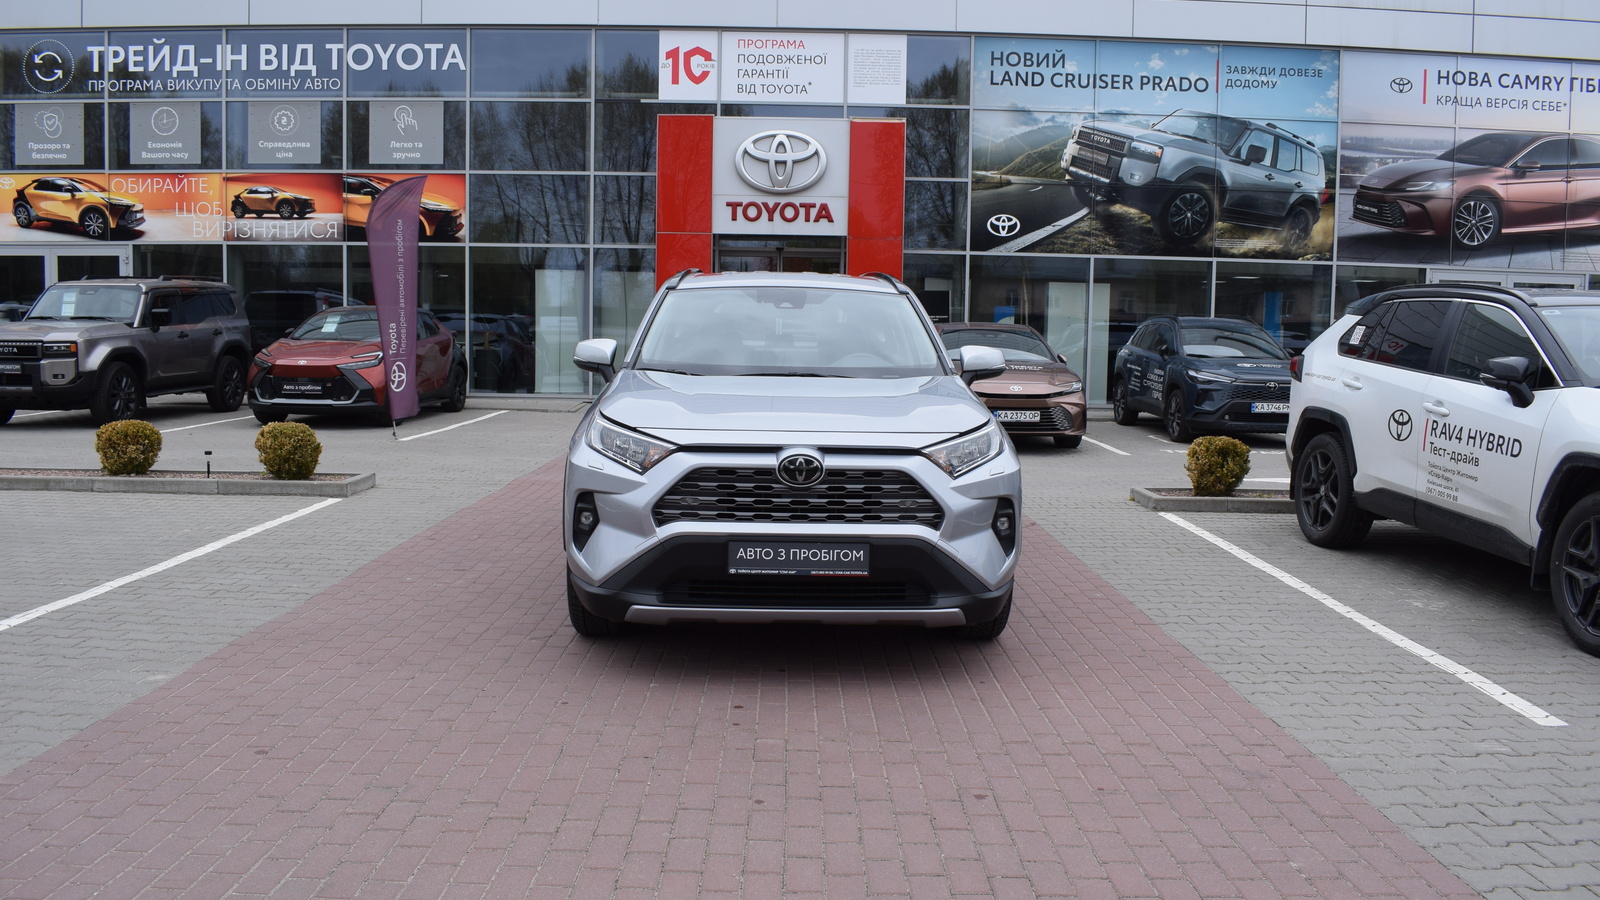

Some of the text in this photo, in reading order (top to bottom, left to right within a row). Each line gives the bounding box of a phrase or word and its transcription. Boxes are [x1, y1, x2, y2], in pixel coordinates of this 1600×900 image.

[737, 39, 805, 50] ПРОГРАМА
[87, 38, 467, 77] ТРЕЙД-ІН ВІД TOYOTA
[737, 53, 828, 65] ПОДОВЖЕНОЇ
[990, 49, 1066, 69] НОВИЙ
[665, 46, 713, 85] 10
[737, 66, 789, 79] ГАРАНТІЇ
[1226, 65, 1324, 79] ЗАВЖДИ ДОВЕЗЕ
[88, 78, 341, 92] ПРОГРАМА ВИКУПУ ТА ОБМІНУ АВТО
[990, 70, 1209, 93] LAND CRUISER PRADO
[1225, 78, 1278, 90] ДОДОМУ
[1437, 70, 1492, 88] НОВА
[1497, 73, 1564, 92] CAMRY
[737, 83, 757, 95] ВІД
[1436, 95, 1483, 108] КРАЩА
[1486, 98, 1528, 110] ВЕРСІЯ
[28, 142, 61, 150] Прозоро
[258, 140, 311, 148] Справедлива
[390, 140, 413, 148] Легко
[1090, 134, 1111, 144] TOYOTA
[141, 151, 170, 159] Вашого
[275, 151, 293, 159] ціна
[392, 152, 421, 160] зручно
[111, 175, 214, 196] ОБИРАЙТЕ,
[175, 201, 223, 219] ЩОБ
[726, 201, 835, 223] TOYOTA
[193, 221, 338, 238] ВИРІЗНЯТИСЯ
[395, 219, 405, 257] пробігом
[396, 264, 405, 308] автомобілі
[399, 309, 408, 354] Перевірені
[389, 323, 399, 355] Toyota
[1266, 403, 1281, 411] 3746
[1009, 411, 1028, 420] 2375
[1430, 420, 1522, 458] RAV4 HYBRID
[1429, 441, 1480, 467] Тест-драйв
[1456, 470, 1479, 483] Житомир
[736, 548, 864, 562] АВТО З ПРОБІГОМ
